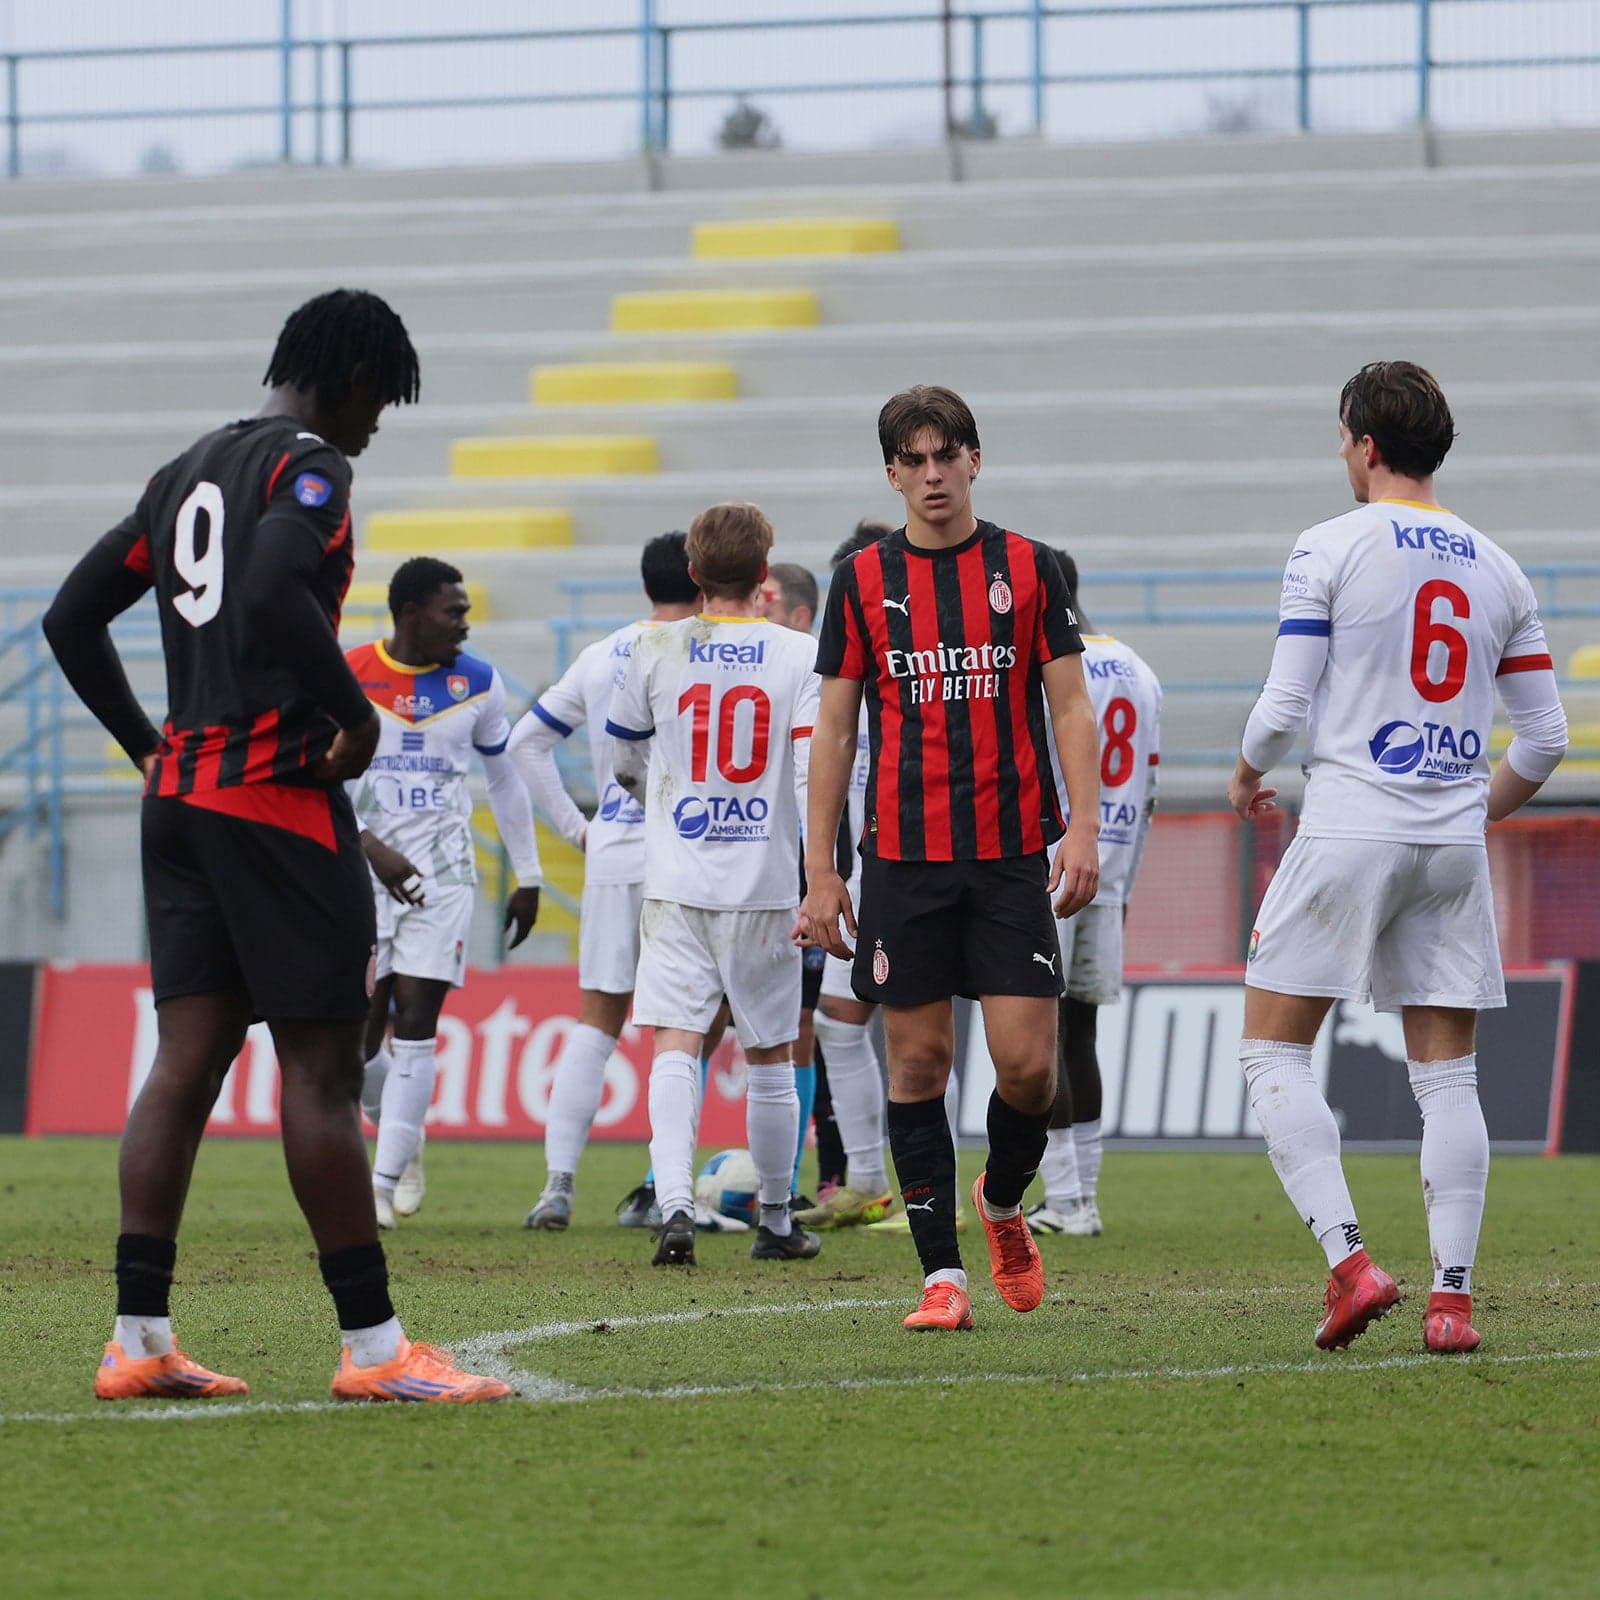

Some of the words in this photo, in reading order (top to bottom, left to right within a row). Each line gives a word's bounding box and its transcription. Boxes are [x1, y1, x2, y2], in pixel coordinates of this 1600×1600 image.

[171, 481, 225, 629] 9
[1391, 520, 1476, 560] kreal
[1431, 552, 1478, 570] INFISSI
[689, 637, 765, 664] kreal
[1410, 579, 1471, 703] 6
[884, 642, 1017, 678] Emirates
[1085, 658, 1136, 680] krea
[910, 677, 936, 704] FLY
[942, 673, 1000, 701] BETTER
[678, 683, 771, 783] 10
[1100, 697, 1137, 788] 8
[1422, 722, 1481, 760] TAO
[1423, 757, 1474, 775] AMIENTE
[707, 797, 768, 821] TAO
[710, 825, 767, 835] AMBIENTE
